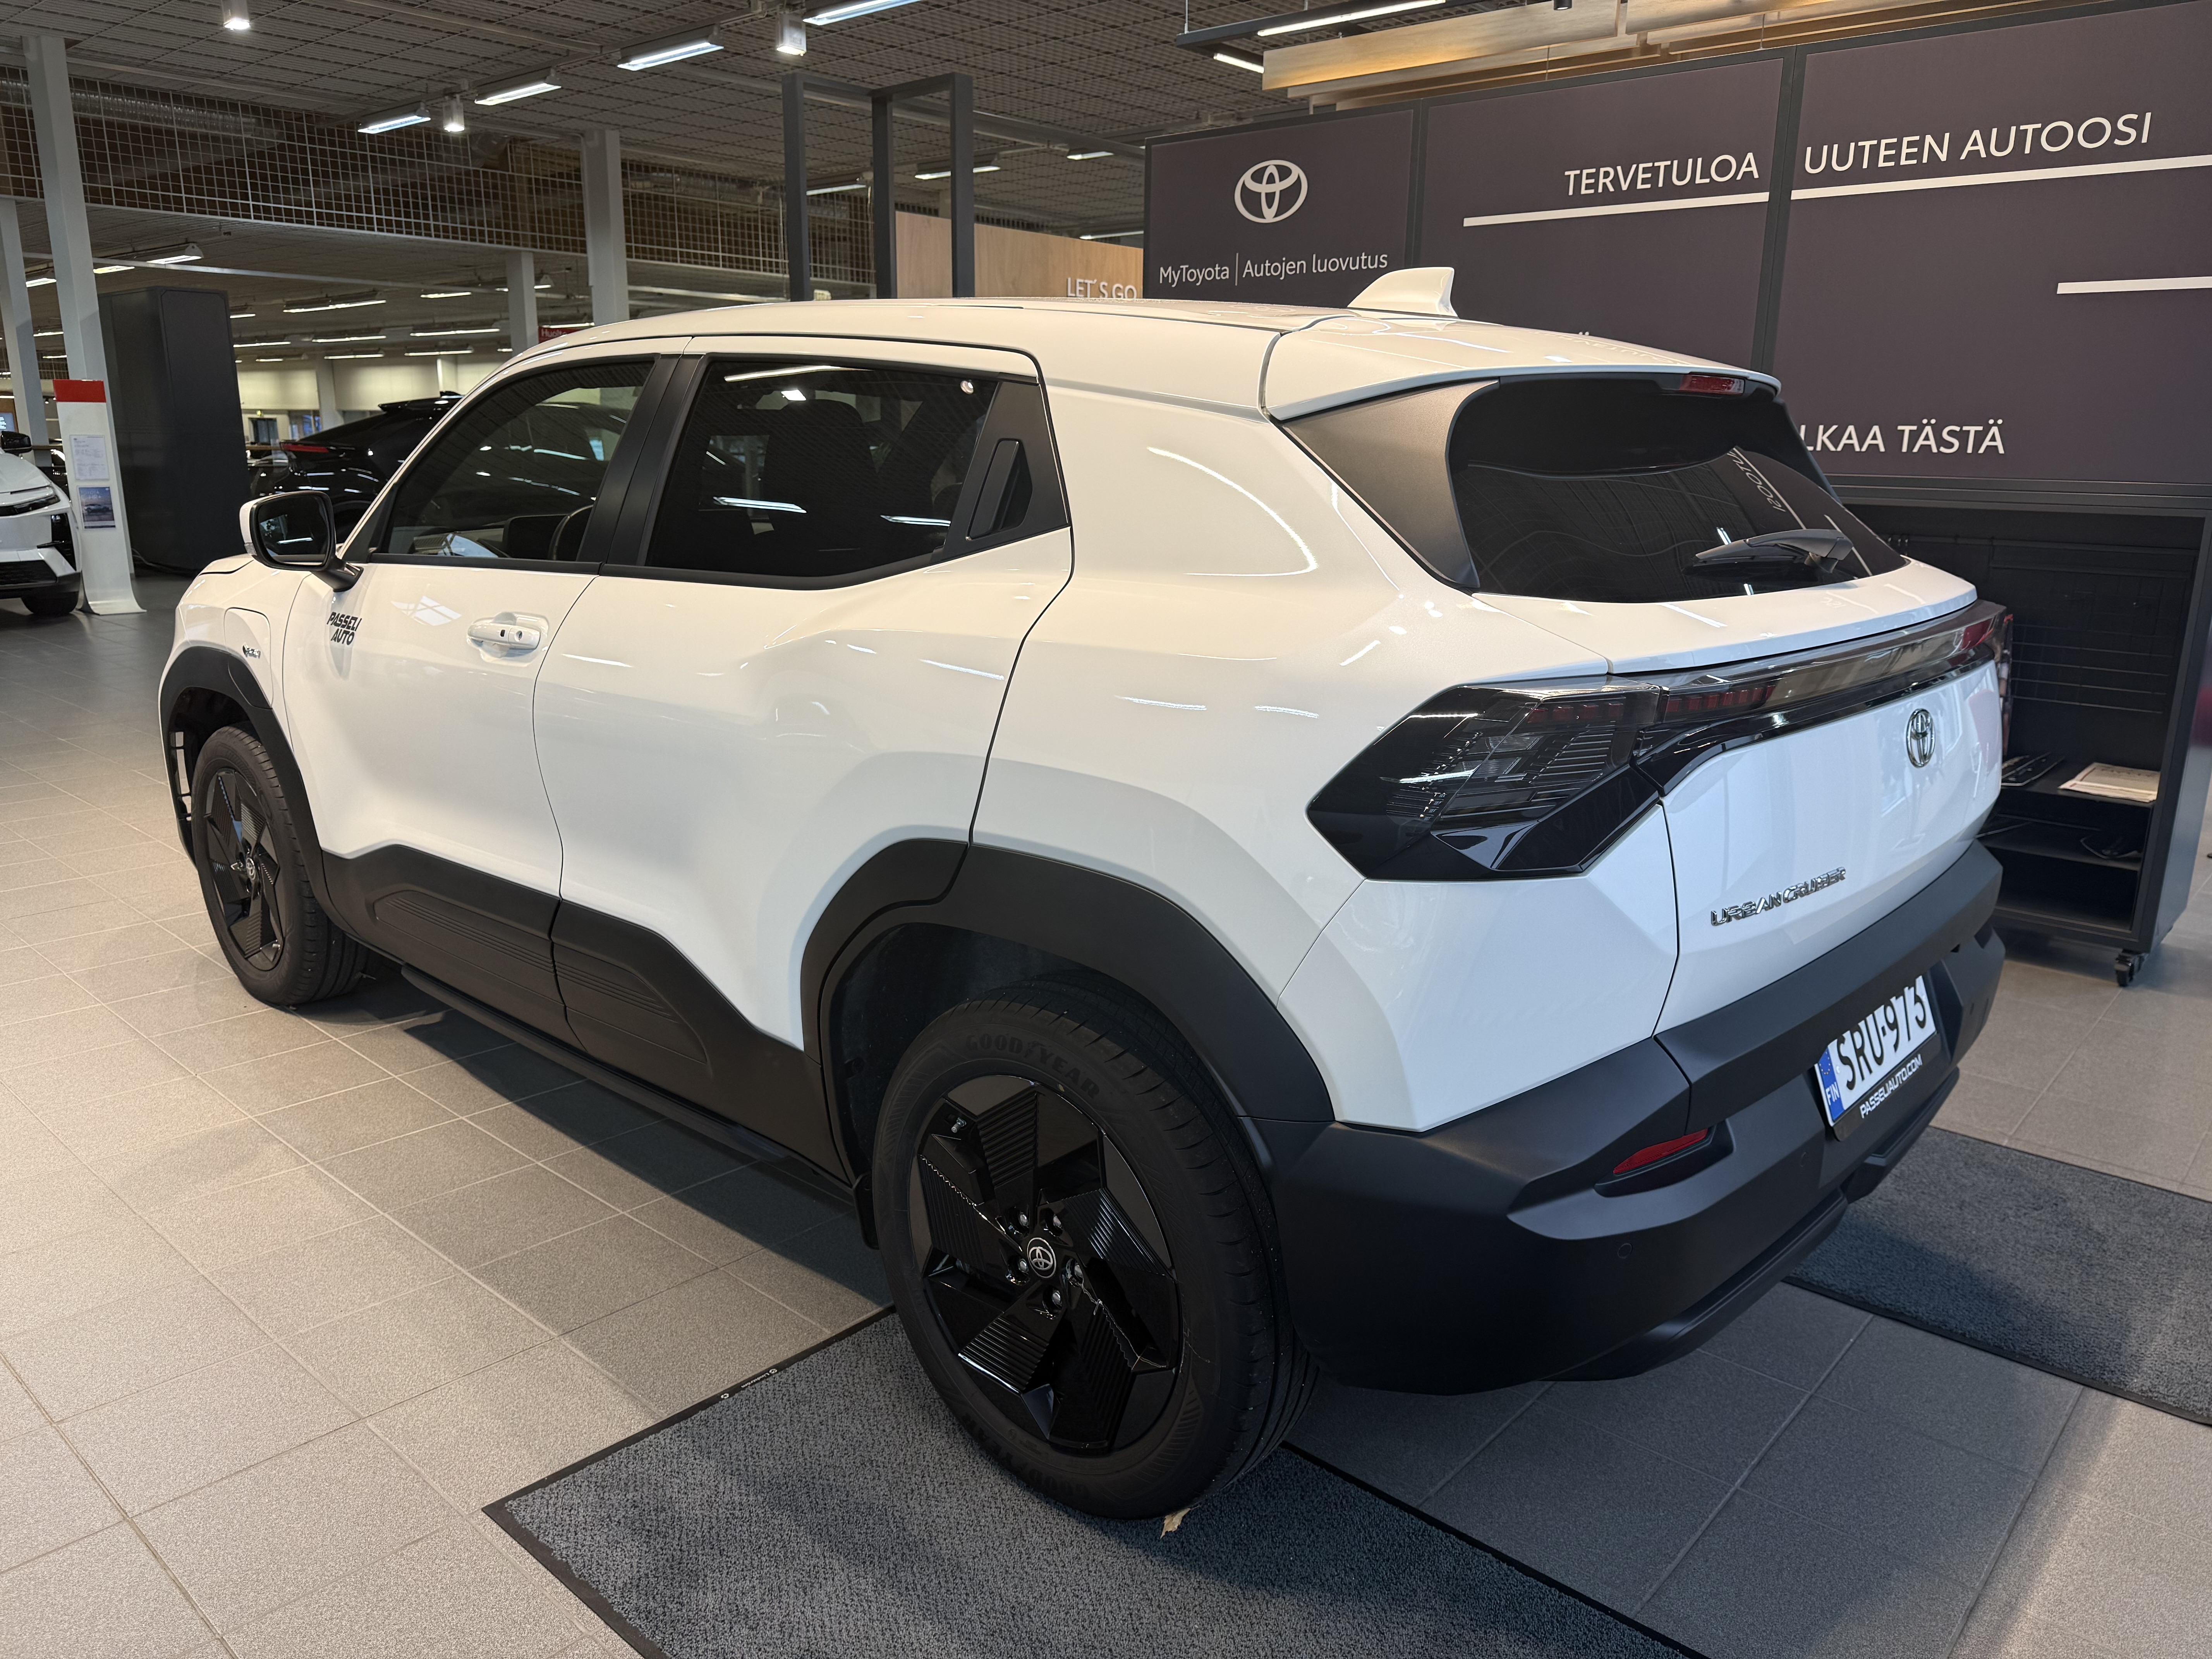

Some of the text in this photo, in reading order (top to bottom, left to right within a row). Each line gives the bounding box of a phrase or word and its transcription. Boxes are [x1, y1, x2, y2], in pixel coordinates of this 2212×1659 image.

[1565, 112, 2152, 196] TERVETULOA UUTEEN AUTOOSI
[1159, 252, 1388, 287] MyToyota Autojen luovutus
[1112, 283, 1137, 299] GO
[1897, 419, 2004, 454] TÄSTÄ
[326, 611, 362, 632] PASSELI
[330, 628, 355, 646] AUTO
[1711, 866, 1846, 926] URBAN CRUISER
[965, 1033, 1100, 1099] GOODYEAR
[1826, 1082, 1840, 1106] FIN
